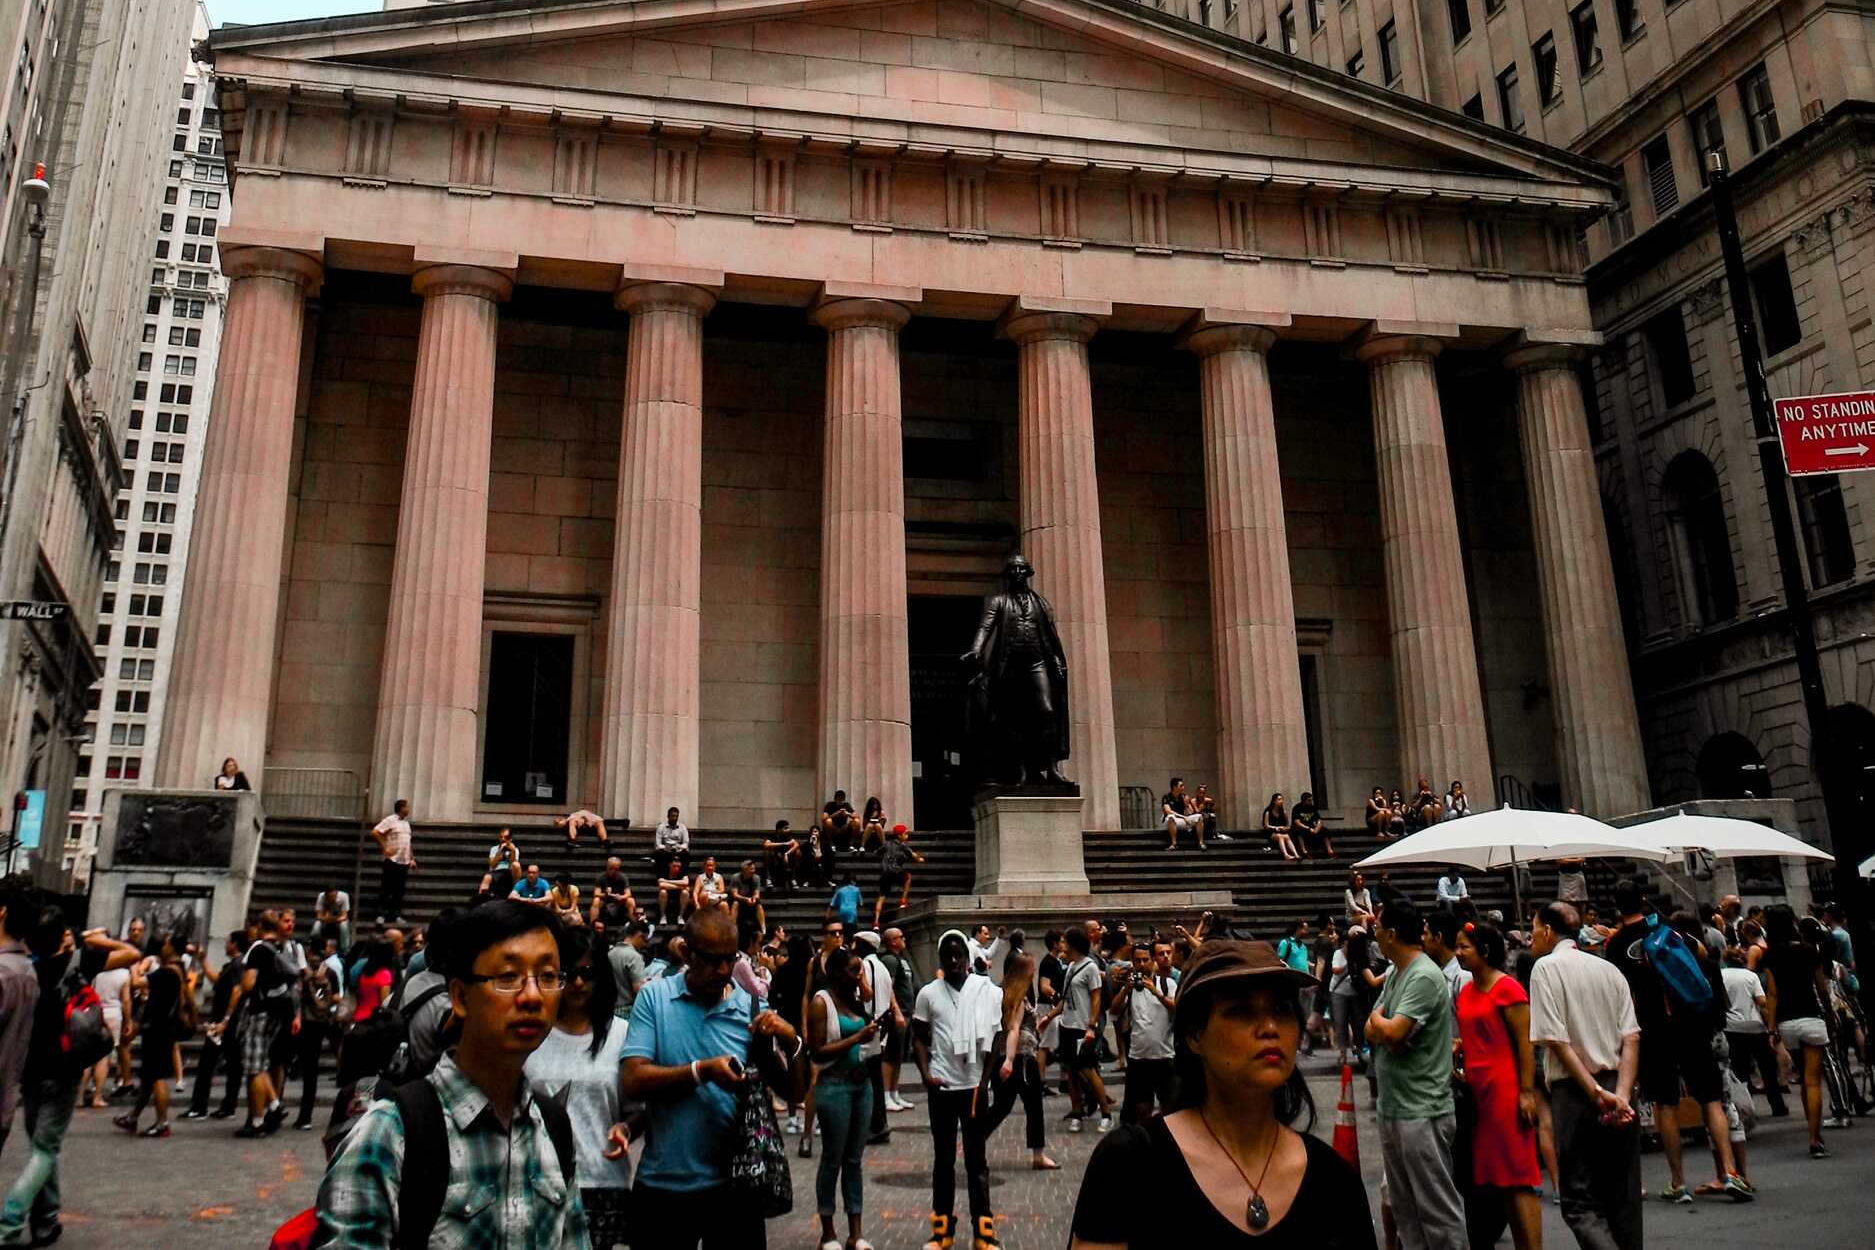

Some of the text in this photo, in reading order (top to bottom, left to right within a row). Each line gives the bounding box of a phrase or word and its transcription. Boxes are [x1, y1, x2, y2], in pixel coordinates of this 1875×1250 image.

[1783, 405, 1805, 422] NO
[1801, 420, 1875, 442] ANYTIME
[16, 605, 53, 619] WALL
